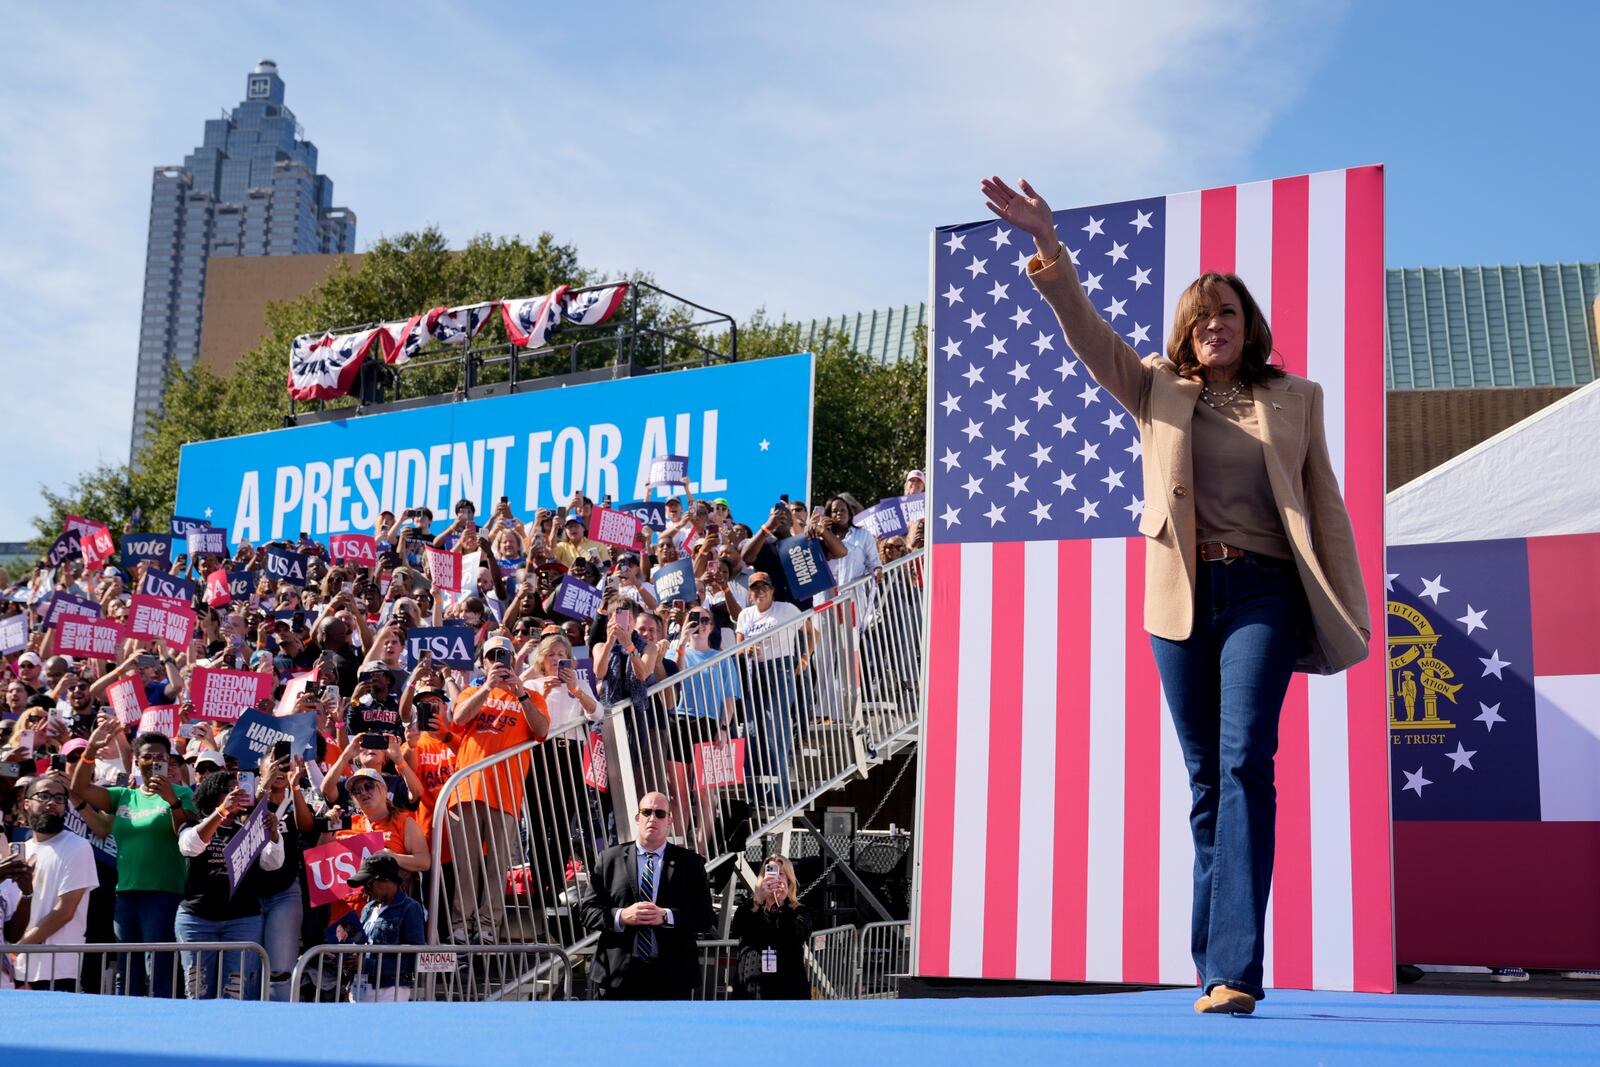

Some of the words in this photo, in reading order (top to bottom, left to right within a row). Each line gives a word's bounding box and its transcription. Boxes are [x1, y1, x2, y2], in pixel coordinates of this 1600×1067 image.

[231, 471, 260, 544] A
[271, 435, 515, 540] PRESIDENT
[525, 422, 623, 512] FOR
[633, 409, 728, 500] ALL
[600, 510, 636, 528] FREEDOM
[876, 507, 898, 521] VOTE
[172, 520, 206, 535] US
[599, 519, 635, 538] FREEDOM
[880, 518, 902, 533] WIN
[127, 538, 166, 556] vote
[597, 529, 634, 547] FREEDOM
[49, 537, 81, 566] USA
[332, 541, 375, 560] USA
[267, 553, 305, 579] USA
[789, 545, 812, 586] HARRIS
[803, 548, 818, 576] WALZ
[146, 574, 187, 600] USA
[229, 577, 248, 595] te
[577, 588, 592, 603] WE
[561, 584, 578, 610] WHEN
[132, 605, 151, 633] WHEN
[150, 608, 167, 624] WE
[167, 610, 190, 631] VOTE
[575, 604, 590, 617] WE
[60, 621, 77, 649] WHEN
[76, 622, 93, 637] WE
[94, 624, 118, 641] VOTE
[148, 620, 166, 637] WE
[165, 624, 187, 645] WIN
[75, 636, 92, 652] WE
[92, 638, 116, 654] WIN
[410, 636, 472, 661] USA
[1421, 660, 1450, 677] MODER
[206, 672, 258, 692] FREEDOM
[1424, 678, 1450, 693] ATION
[204, 687, 256, 706] FREEDOM
[202, 701, 246, 719] FREEDO
[249, 740, 268, 755] WA
[1404, 735, 1446, 745] TRUST
[420, 953, 454, 963] NATIONAL
